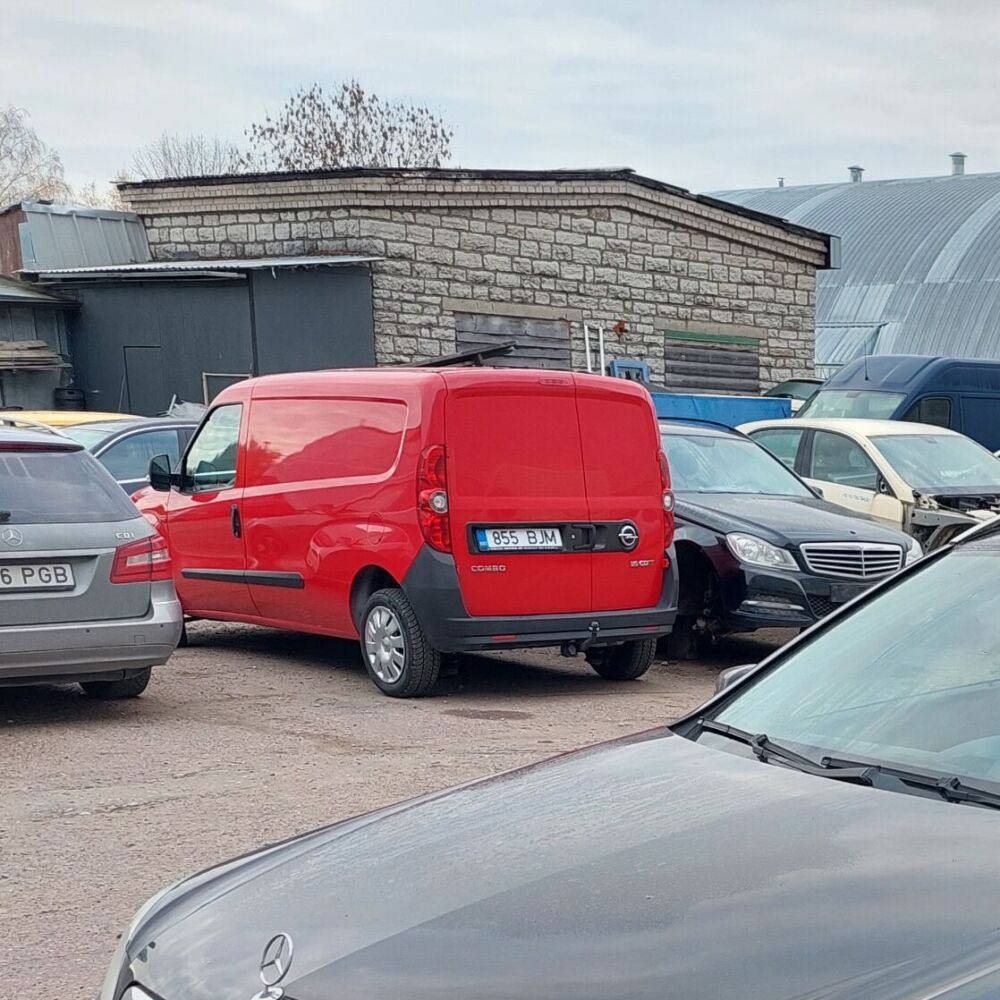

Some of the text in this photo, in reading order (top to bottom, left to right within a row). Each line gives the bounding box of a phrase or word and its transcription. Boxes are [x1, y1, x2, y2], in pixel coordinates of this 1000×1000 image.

[492, 530, 556, 545] 855 BJM
[0, 566, 68, 585] 6 PGB
